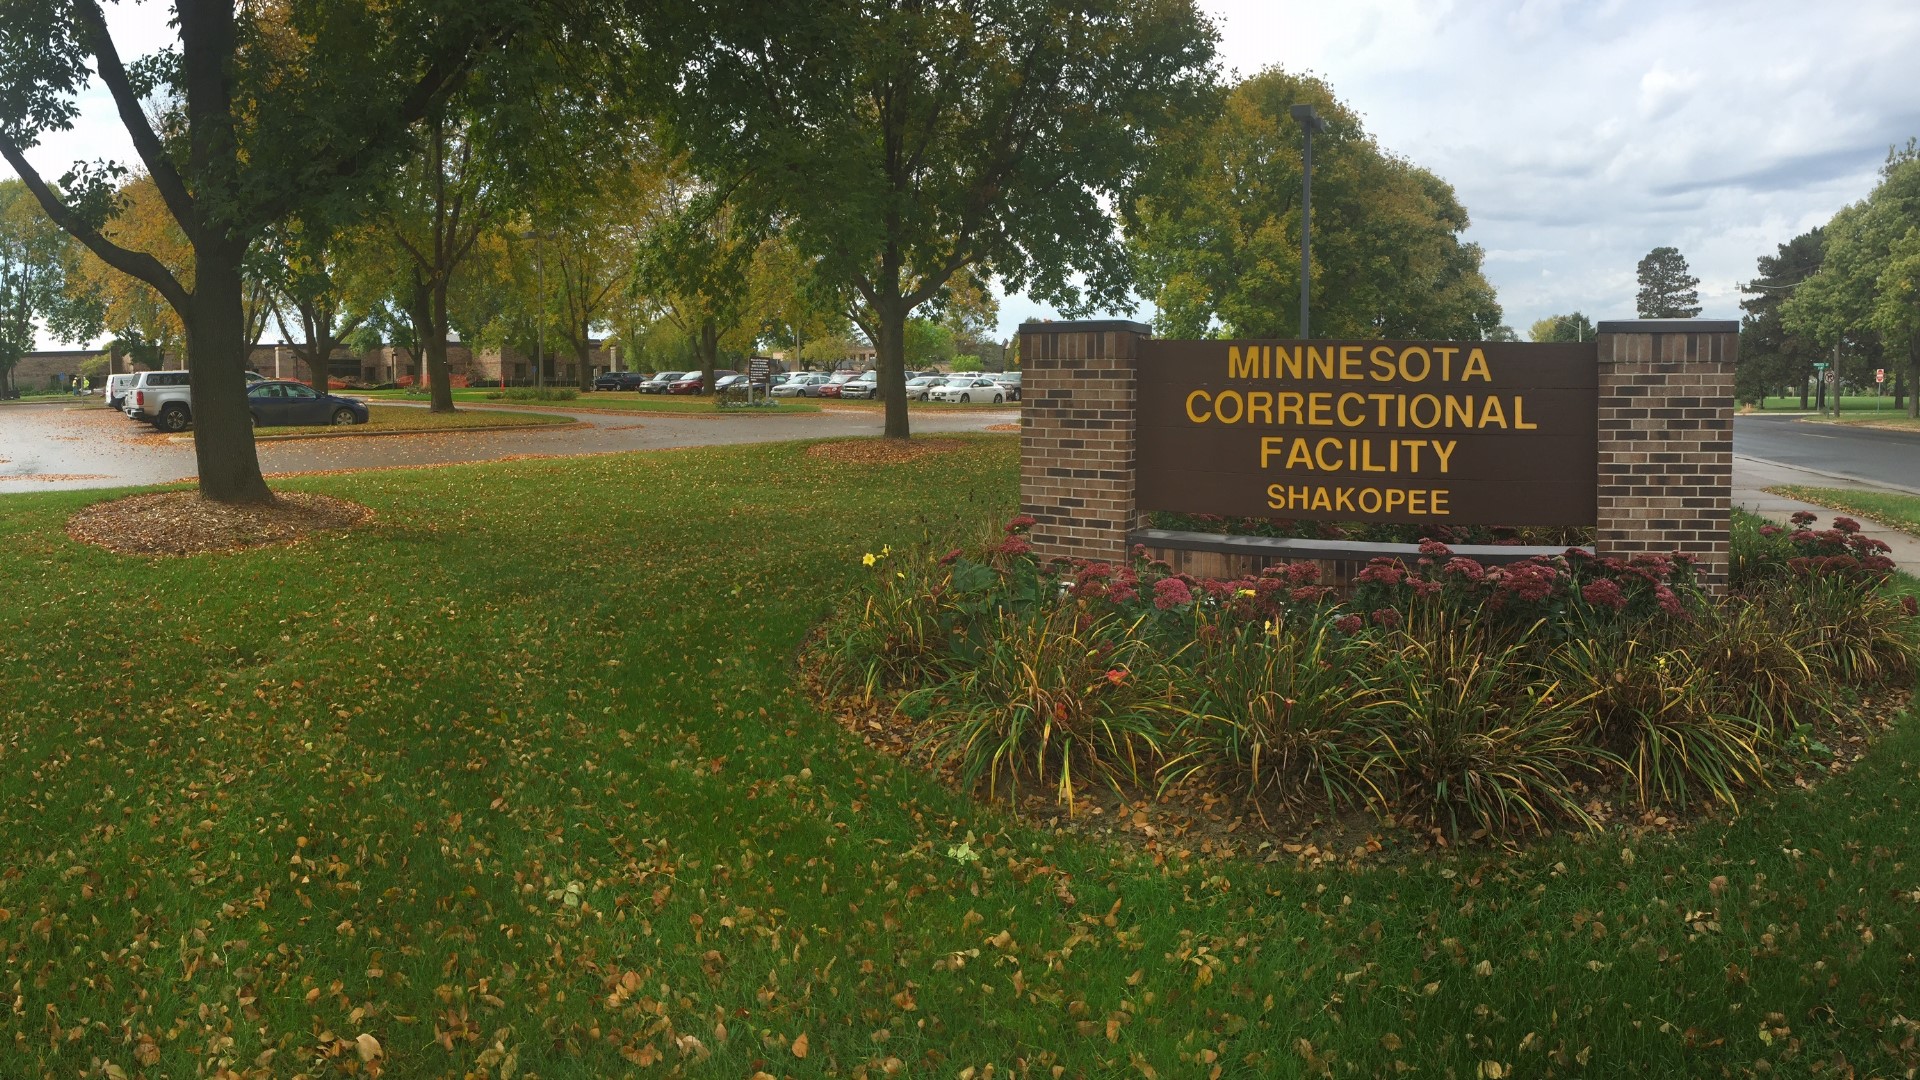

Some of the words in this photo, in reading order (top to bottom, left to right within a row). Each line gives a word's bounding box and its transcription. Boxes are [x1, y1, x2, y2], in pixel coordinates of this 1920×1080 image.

[1228, 345, 1492, 383] MINNESOTA
[1185, 389, 1538, 430] CORRECTIONAL
[1260, 436, 1457, 473] FACILITY
[1267, 483, 1450, 515] SHAKOPEE
